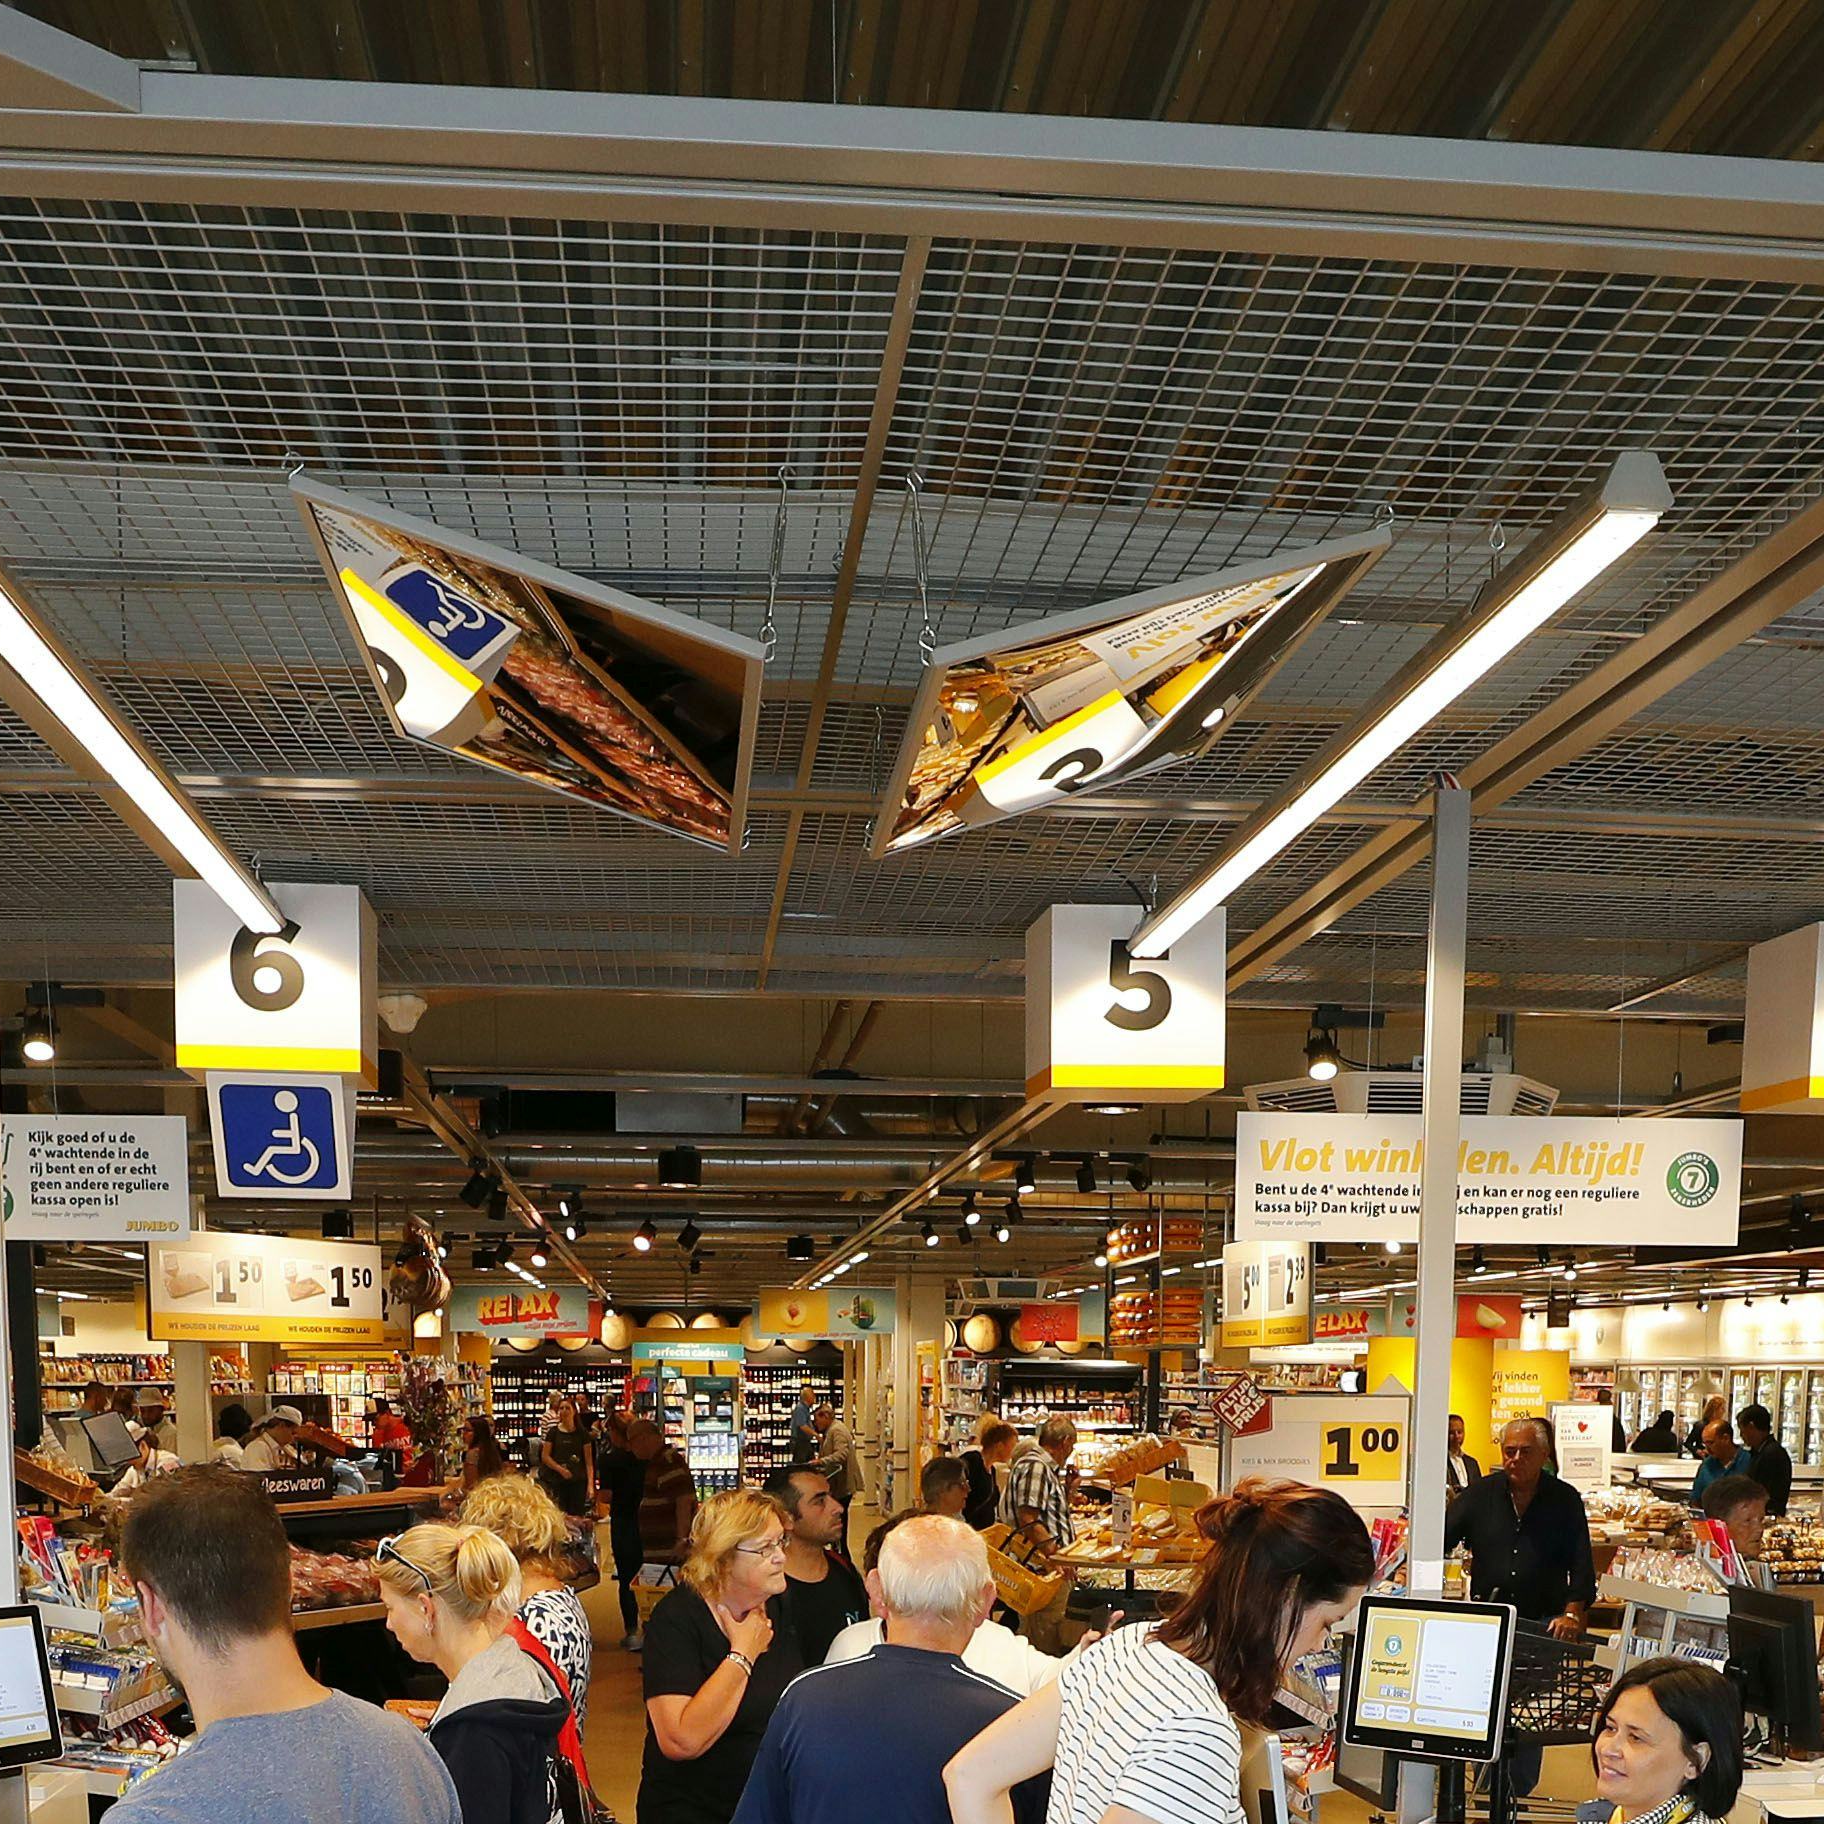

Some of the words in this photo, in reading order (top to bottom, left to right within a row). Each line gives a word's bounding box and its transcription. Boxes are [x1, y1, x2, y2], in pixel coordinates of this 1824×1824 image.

[230, 918, 304, 1011] 6
[1103, 939, 1172, 1031] 5
[28, 1131, 53, 1145] Kijk
[57, 1132, 88, 1146] goed
[91, 1131, 105, 1143] of
[108, 1135, 117, 1144] u
[119, 1132, 136, 1144] de
[45, 1147, 115, 1159] wachtende
[118, 1148, 130, 1159] in
[133, 1148, 149, 1159] de
[29, 1163, 43, 1177] rij
[46, 1163, 75, 1175] bent
[78, 1166, 94, 1175] en
[97, 1163, 111, 1175] of
[114, 1167, 127, 1175] er
[130, 1164, 157, 1175] echt
[1259, 1138, 1335, 1172] Vlot
[1344, 1139, 1521, 1175] winlen.
[1528, 1141, 1645, 1186] Altijd!
[30, 1181, 62, 1192] geen
[65, 1179, 109, 1190] andere
[112, 1179, 170, 1193] reguliere
[1687, 1171, 1699, 1188] 7
[1255, 1183, 1286, 1195] Bent
[1289, 1186, 1297, 1195] u
[1301, 1183, 1317, 1195] de
[1337, 1183, 1409, 1196] wachtende
[1463, 1188, 1480, 1198] en
[1483, 1185, 1508, 1198] kan
[1510, 1188, 1524, 1198] er
[1527, 1188, 1551, 1201] nog
[1555, 1189, 1578, 1199] een
[1581, 1186, 1639, 1201] reguliere
[31, 1194, 66, 1205] kassa
[69, 1197, 101, 1208] open
[104, 1194, 119, 1206] is!
[1255, 1201, 1290, 1213] kassa
[1294, 1201, 1318, 1217] bij?
[1321, 1202, 1347, 1213] Dan
[1350, 1202, 1386, 1217] krijgt
[1389, 1205, 1397, 1214] u
[1401, 1205, 1421, 1214] uw
[1522, 1203, 1563, 1218] gratis!
[125, 1220, 179, 1232] JUMBO
[477, 1292, 560, 1326] RELAX
[1315, 1311, 1369, 1337] ELAX
[648, 1348, 689, 1360] perfecte
[690, 1348, 729, 1358] cadeau
[1219, 1379, 1251, 1413] ALTIJD
[1232, 1395, 1266, 1430] PRIJS
